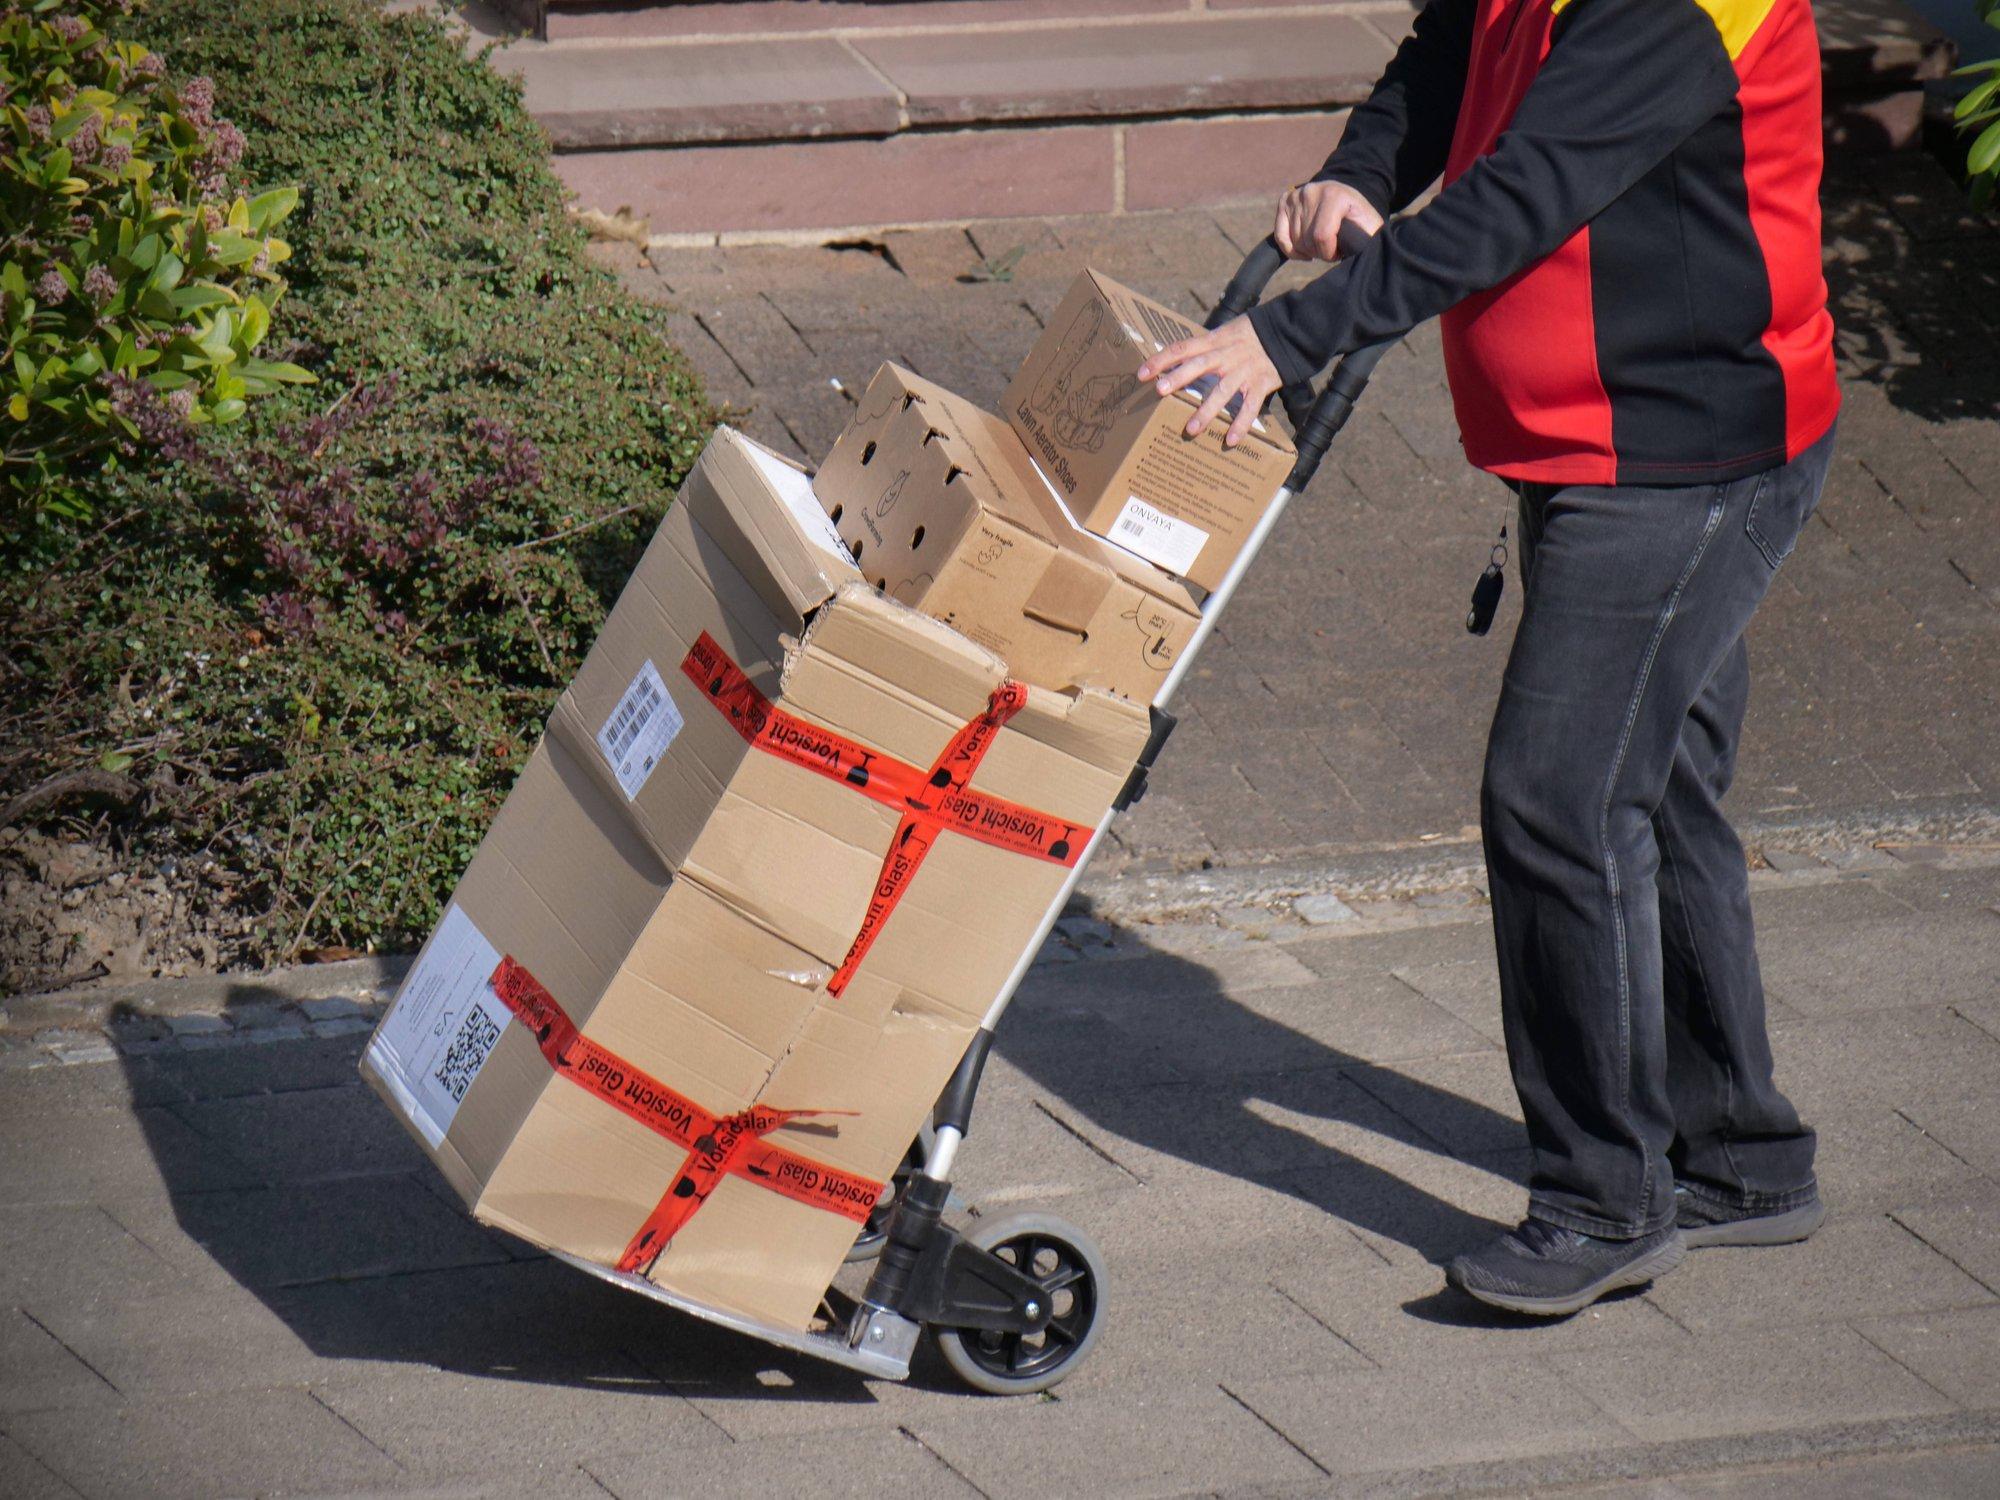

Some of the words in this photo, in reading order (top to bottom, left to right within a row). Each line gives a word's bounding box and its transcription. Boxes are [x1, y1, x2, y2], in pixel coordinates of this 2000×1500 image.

[1017, 398, 1037, 432] Lawn
[1033, 424, 1059, 465] Aerator
[1055, 457, 1077, 494] Shoes
[981, 526, 994, 539] Very
[995, 533, 1014, 548] fragile
[769, 721, 841, 768] Vorsicht
[937, 794, 979, 822] Glas!
[981, 806, 1045, 845] Vorsicht
[879, 853, 911, 898] Glas!
[434, 1011, 453, 1036] V3
[578, 1055, 624, 1091] Glas!
[625, 1080, 692, 1135] Vorsicht
[777, 1160, 819, 1189] Glas!
[821, 1176, 878, 1212] orsicht
